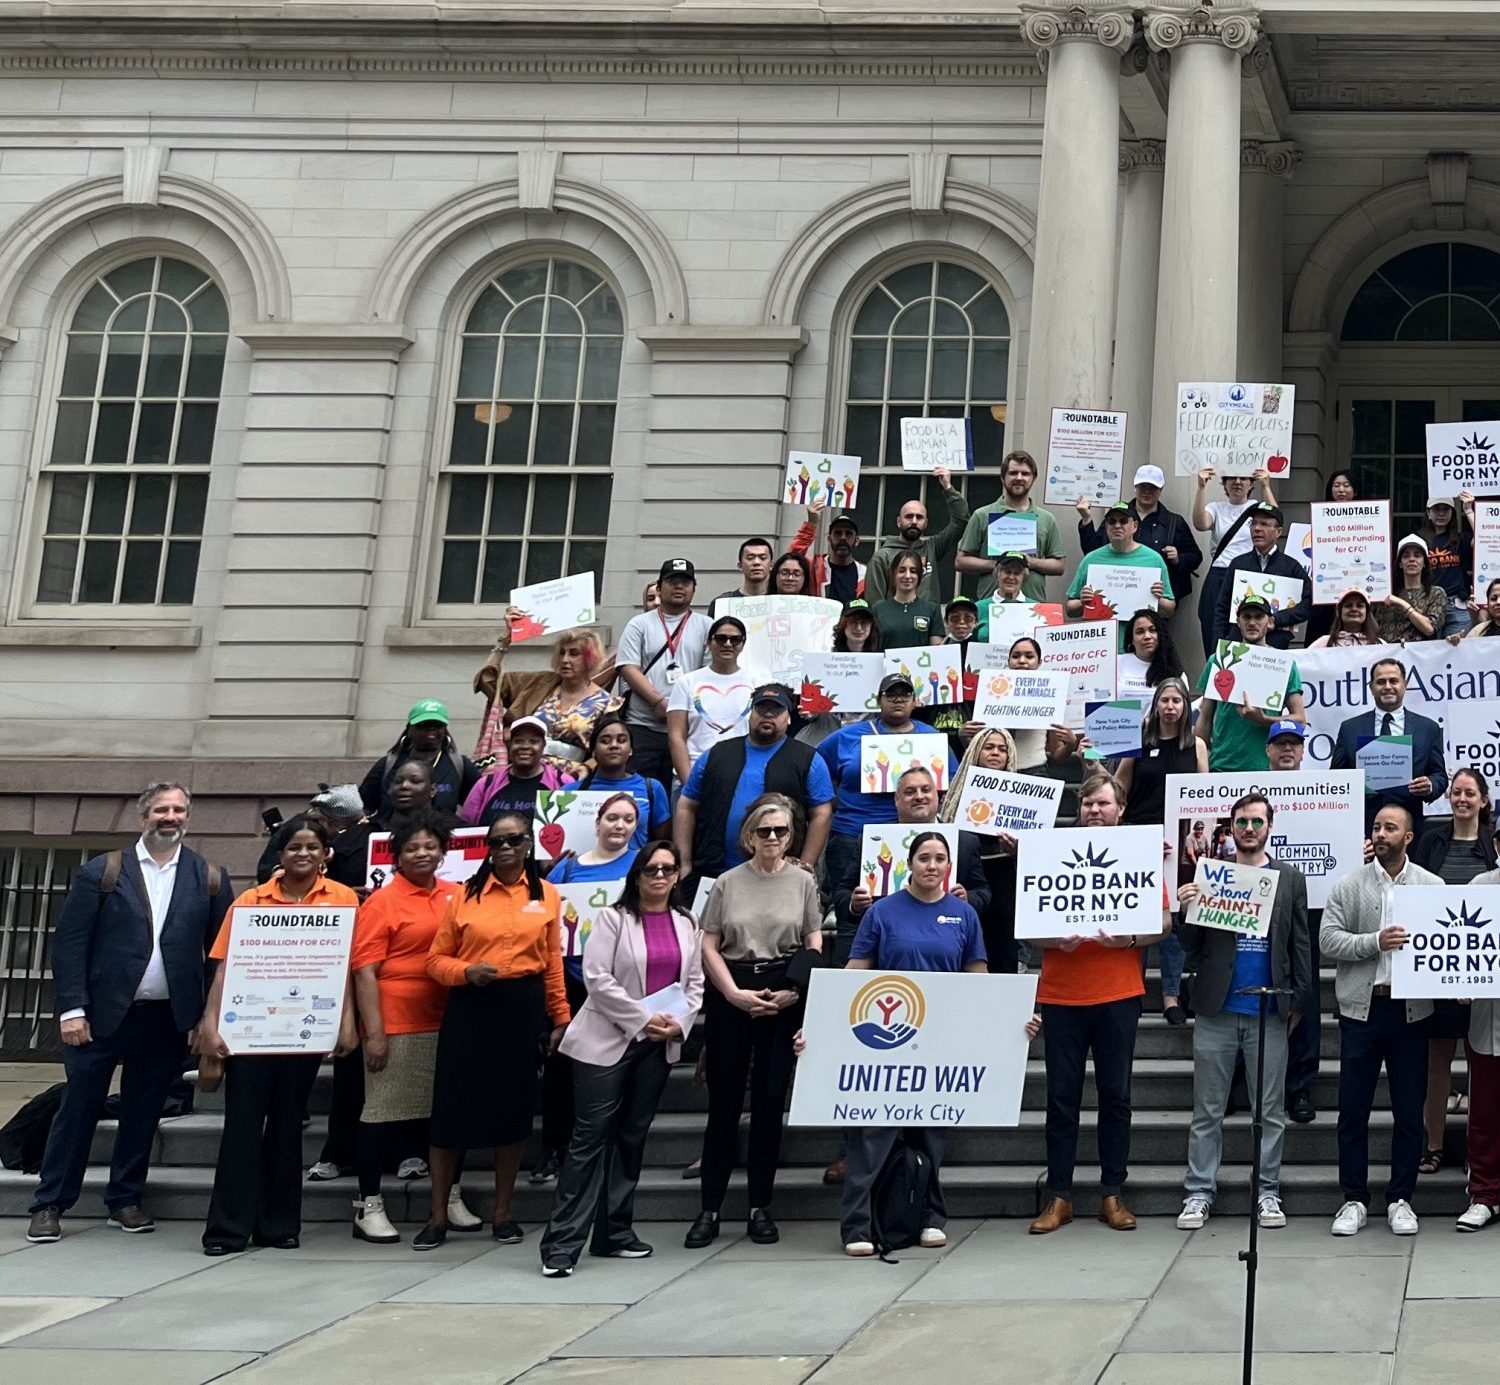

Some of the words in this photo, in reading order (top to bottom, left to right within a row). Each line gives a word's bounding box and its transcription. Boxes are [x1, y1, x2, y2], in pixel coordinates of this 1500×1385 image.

[1065, 412, 1118, 425] ROUNDTABLE
[905, 422, 932, 437] FOOD
[935, 424, 946, 436] IS
[949, 425, 958, 436] A
[906, 438, 947, 450] HUMAN
[922, 450, 965, 466] RIGHT
[1432, 454, 1475, 467] FOOD
[1443, 469, 1475, 480] FOR
[1326, 506, 1380, 516] ROUNDTABLE
[1352, 534, 1385, 543] Funding
[1049, 628, 1107, 642] ROUNDTABLE
[831, 655, 856, 663] Feeding
[1043, 653, 1069, 663] CFOs
[1071, 651, 1083, 661] for
[1087, 649, 1107, 659] CFC
[1015, 677, 1036, 686] EVERY
[1037, 678, 1050, 688] DAY
[1014, 687, 1021, 697] IS
[1022, 688, 1029, 697] A
[1030, 688, 1056, 698] MIRACLE
[983, 704, 1020, 716] FIGHTING
[1022, 705, 1055, 717] HUNGER
[971, 774, 998, 790] FOOD
[999, 780, 1010, 791] IS
[1012, 782, 1057, 801] SURVIVAL
[1180, 786, 1214, 799] Feed
[1219, 785, 1244, 798] Our
[1250, 782, 1350, 796] Communities!
[998, 804, 1022, 817] EVERY
[1022, 809, 1038, 820] DAY
[1180, 805, 1218, 814] Increase
[1221, 804, 1233, 813] CF
[1280, 802, 1290, 811] to
[1292, 801, 1315, 812] $100
[1318, 801, 1349, 811] Million
[995, 815, 1004, 826] IS
[1003, 817, 1008, 828] A
[1272, 837, 1285, 845] NY
[1279, 847, 1326, 858] COMMON
[1204, 863, 1235, 885] WE
[1023, 874, 1086, 892] FOOD
[1092, 871, 1155, 890] BANK
[1210, 883, 1253, 901] Stand
[1038, 894, 1085, 912] FOR
[1092, 892, 1139, 910] NYC
[1198, 896, 1262, 916] AGAINST
[254, 915, 340, 927] ROUNDTABLE
[1197, 908, 1259, 931] HUNGER
[1414, 955, 1460, 972] FOR
[838, 1064, 926, 1092] UNITED
[935, 1065, 986, 1093] WAY
[833, 1104, 877, 1120] New
[884, 1104, 923, 1120] York
[930, 1104, 965, 1124] City
